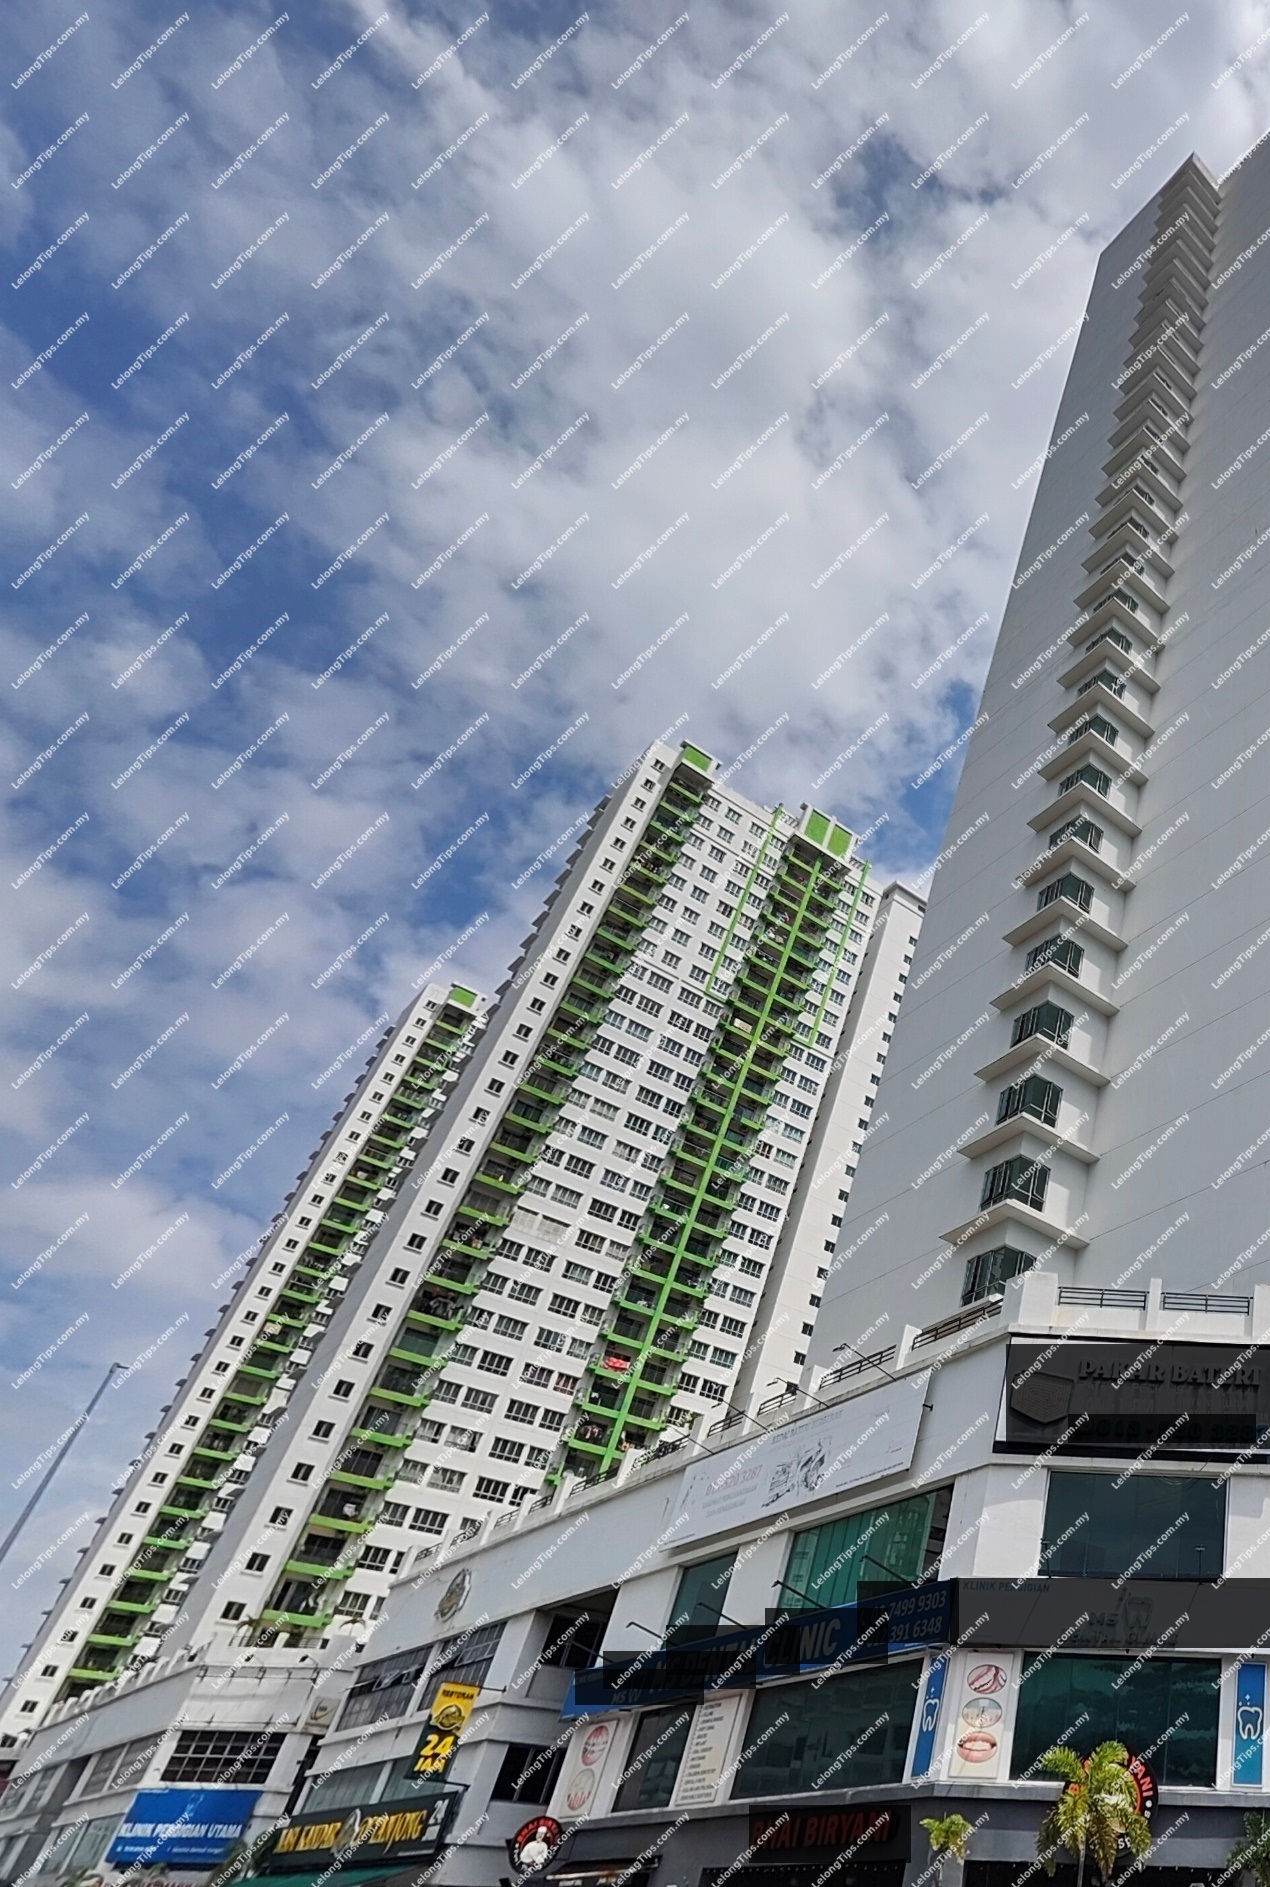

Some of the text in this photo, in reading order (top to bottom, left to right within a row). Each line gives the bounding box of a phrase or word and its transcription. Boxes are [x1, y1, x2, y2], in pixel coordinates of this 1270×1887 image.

[888, 1597, 916, 1618] 7499
[917, 1590, 947, 1612] 9303
[889, 1623, 910, 1642] 391
[912, 1616, 943, 1638] 6348
[419, 1733, 455, 1757] 24
